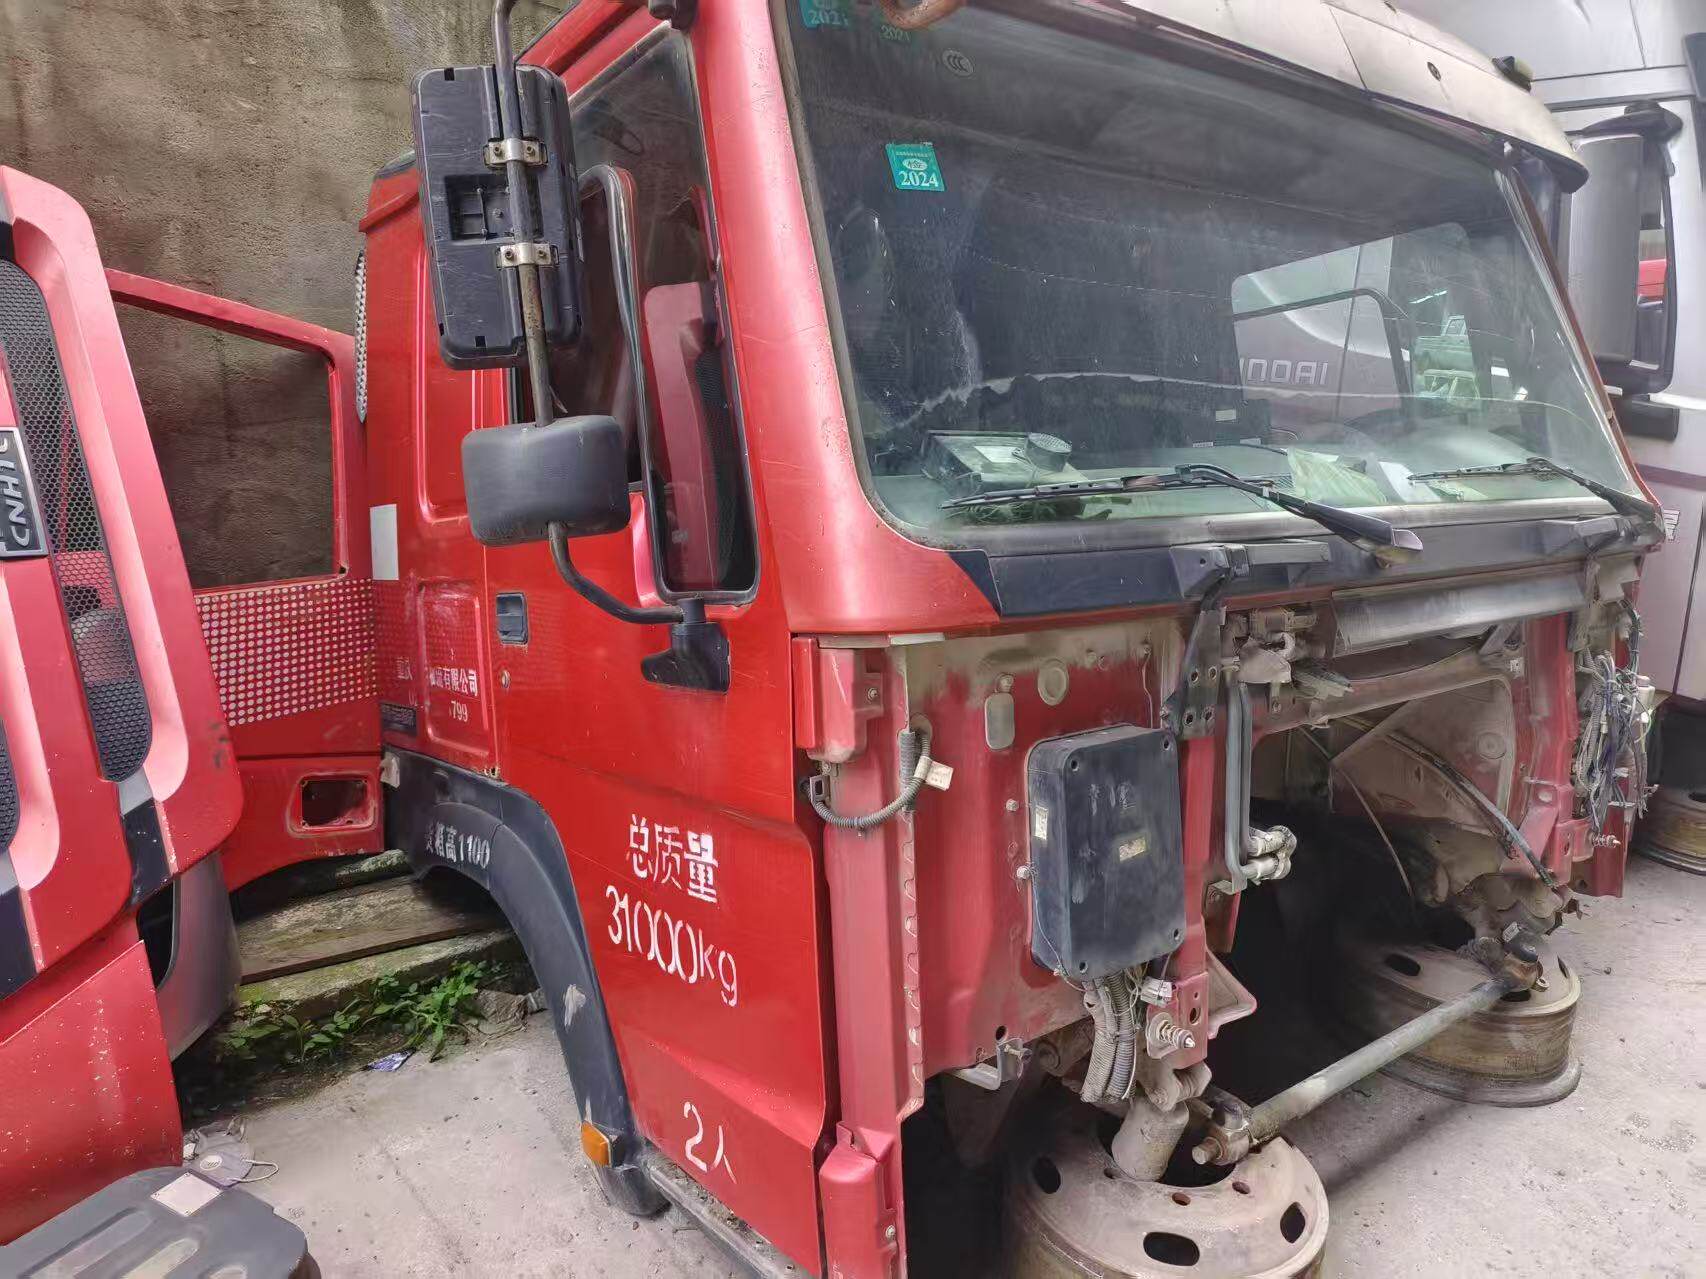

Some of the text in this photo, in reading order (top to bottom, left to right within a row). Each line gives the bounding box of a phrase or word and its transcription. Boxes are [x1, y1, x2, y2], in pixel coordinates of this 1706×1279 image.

[899, 171, 939, 187] 2024
[626, 813, 719, 904] 总质量
